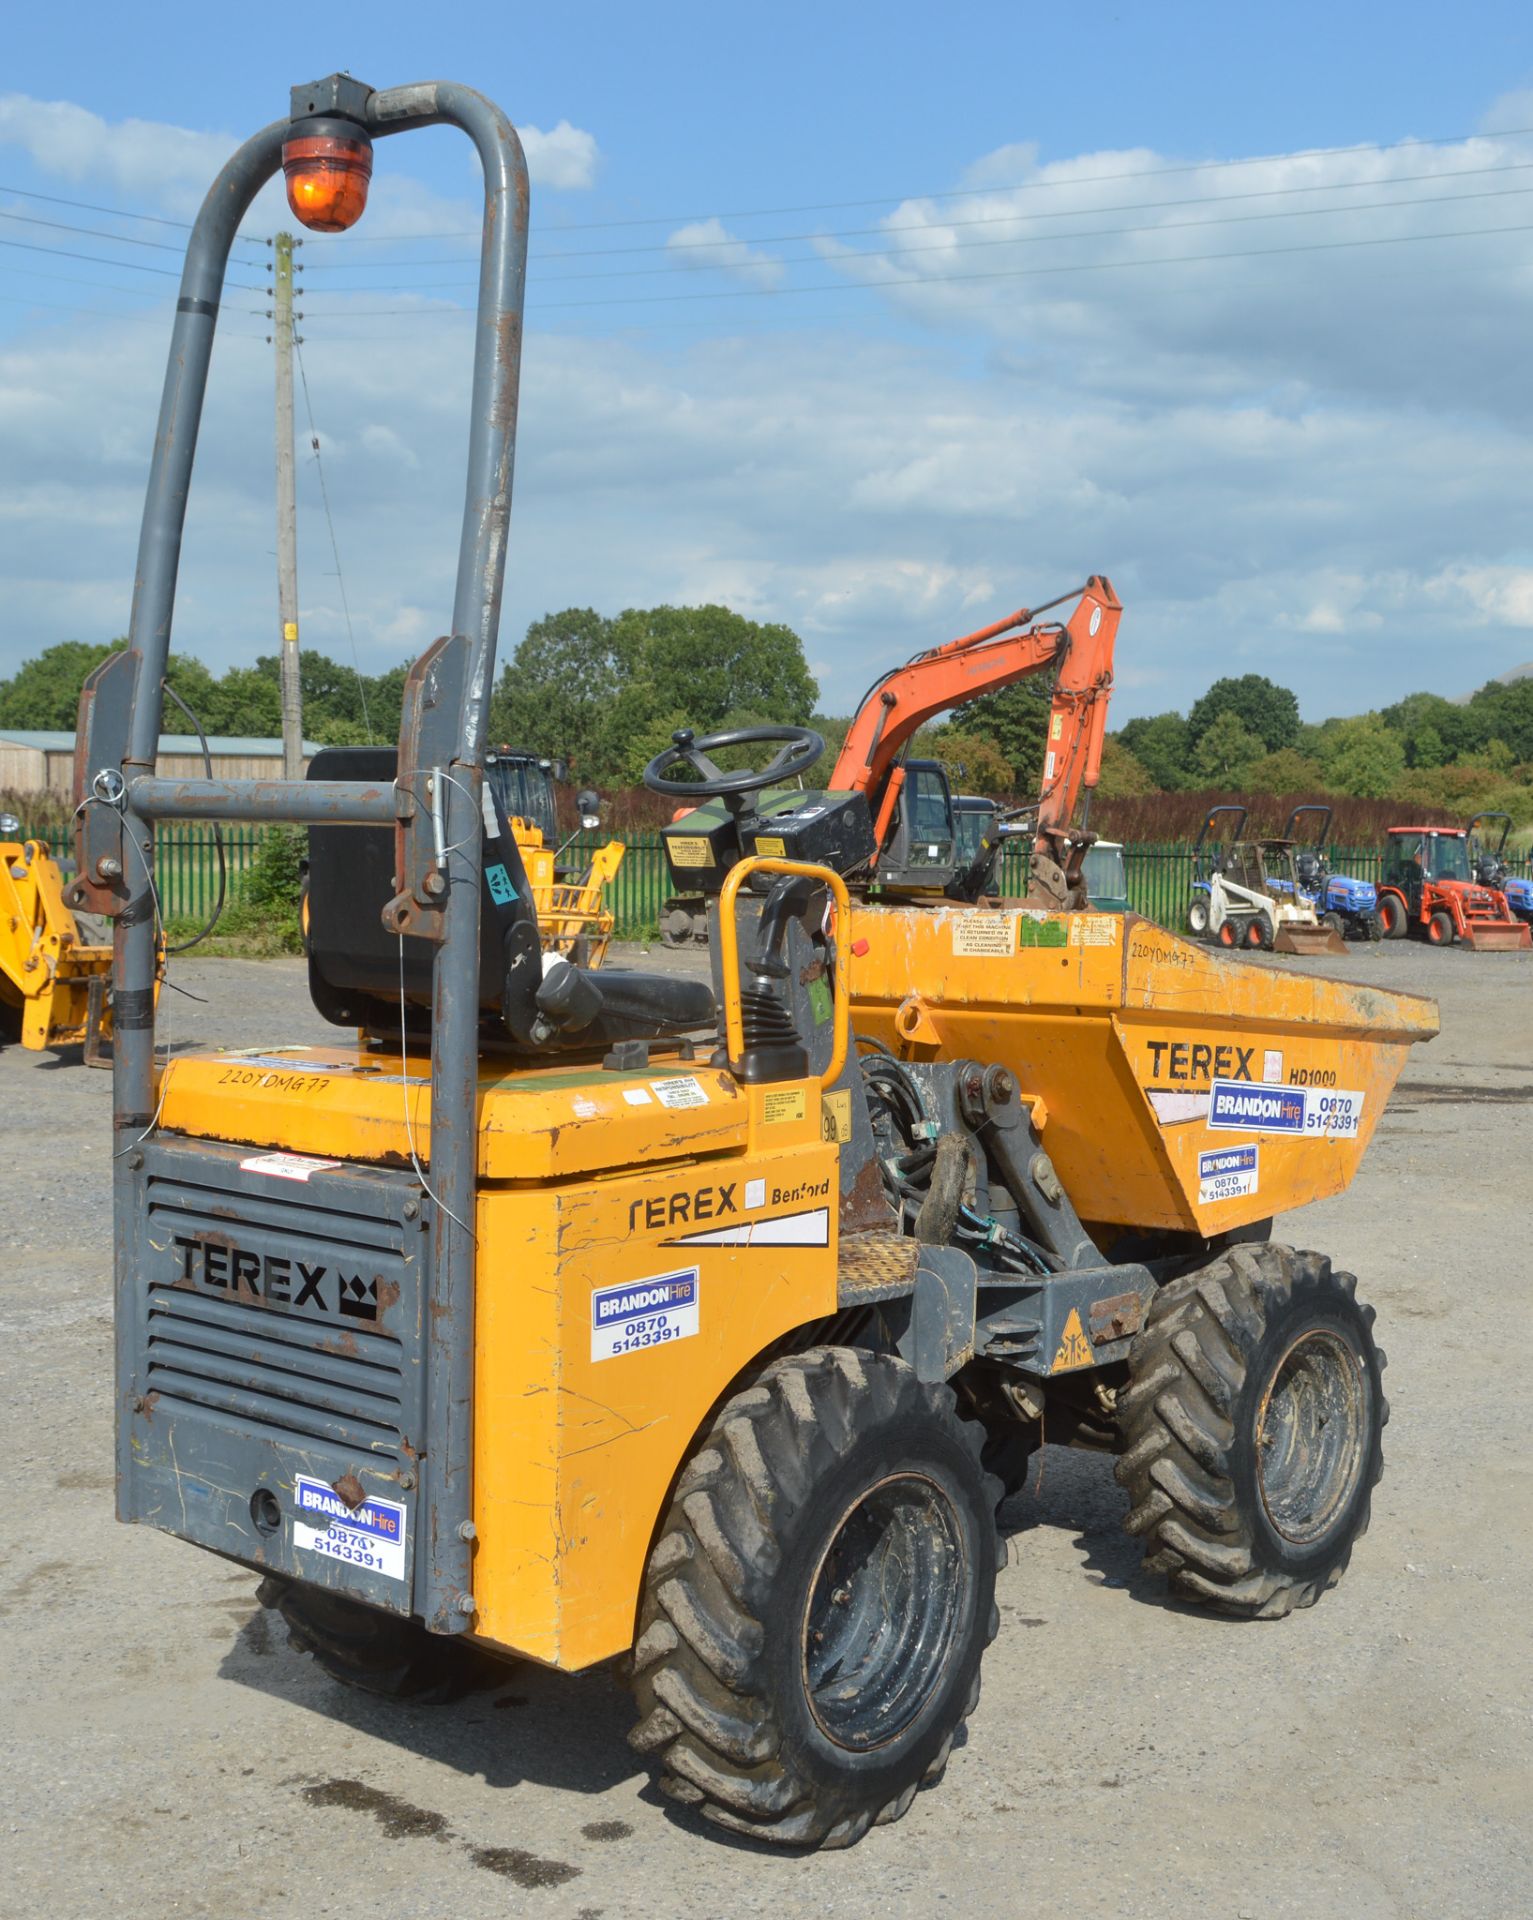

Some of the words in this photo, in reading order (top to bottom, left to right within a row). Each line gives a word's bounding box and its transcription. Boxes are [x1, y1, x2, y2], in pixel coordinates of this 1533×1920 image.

[1147, 1041, 1256, 1082] TEREX
[218, 1068, 330, 1093] 220YDMG77
[1289, 1068, 1337, 1087] HD1000
[1320, 1097, 1352, 1113] 0870
[823, 1115, 836, 1142] 99
[1306, 1113, 1358, 1130] 5143391
[1209, 1185, 1248, 1200] 5143391
[1214, 1176, 1239, 1189] 0870
[629, 1182, 738, 1231] TEREX
[174, 1235, 328, 1312] TEREX
[625, 1315, 668, 1338] 0870
[612, 1325, 680, 1354] 5143391
[327, 1528, 368, 1550] 0870
[314, 1537, 383, 1570] 5143391
